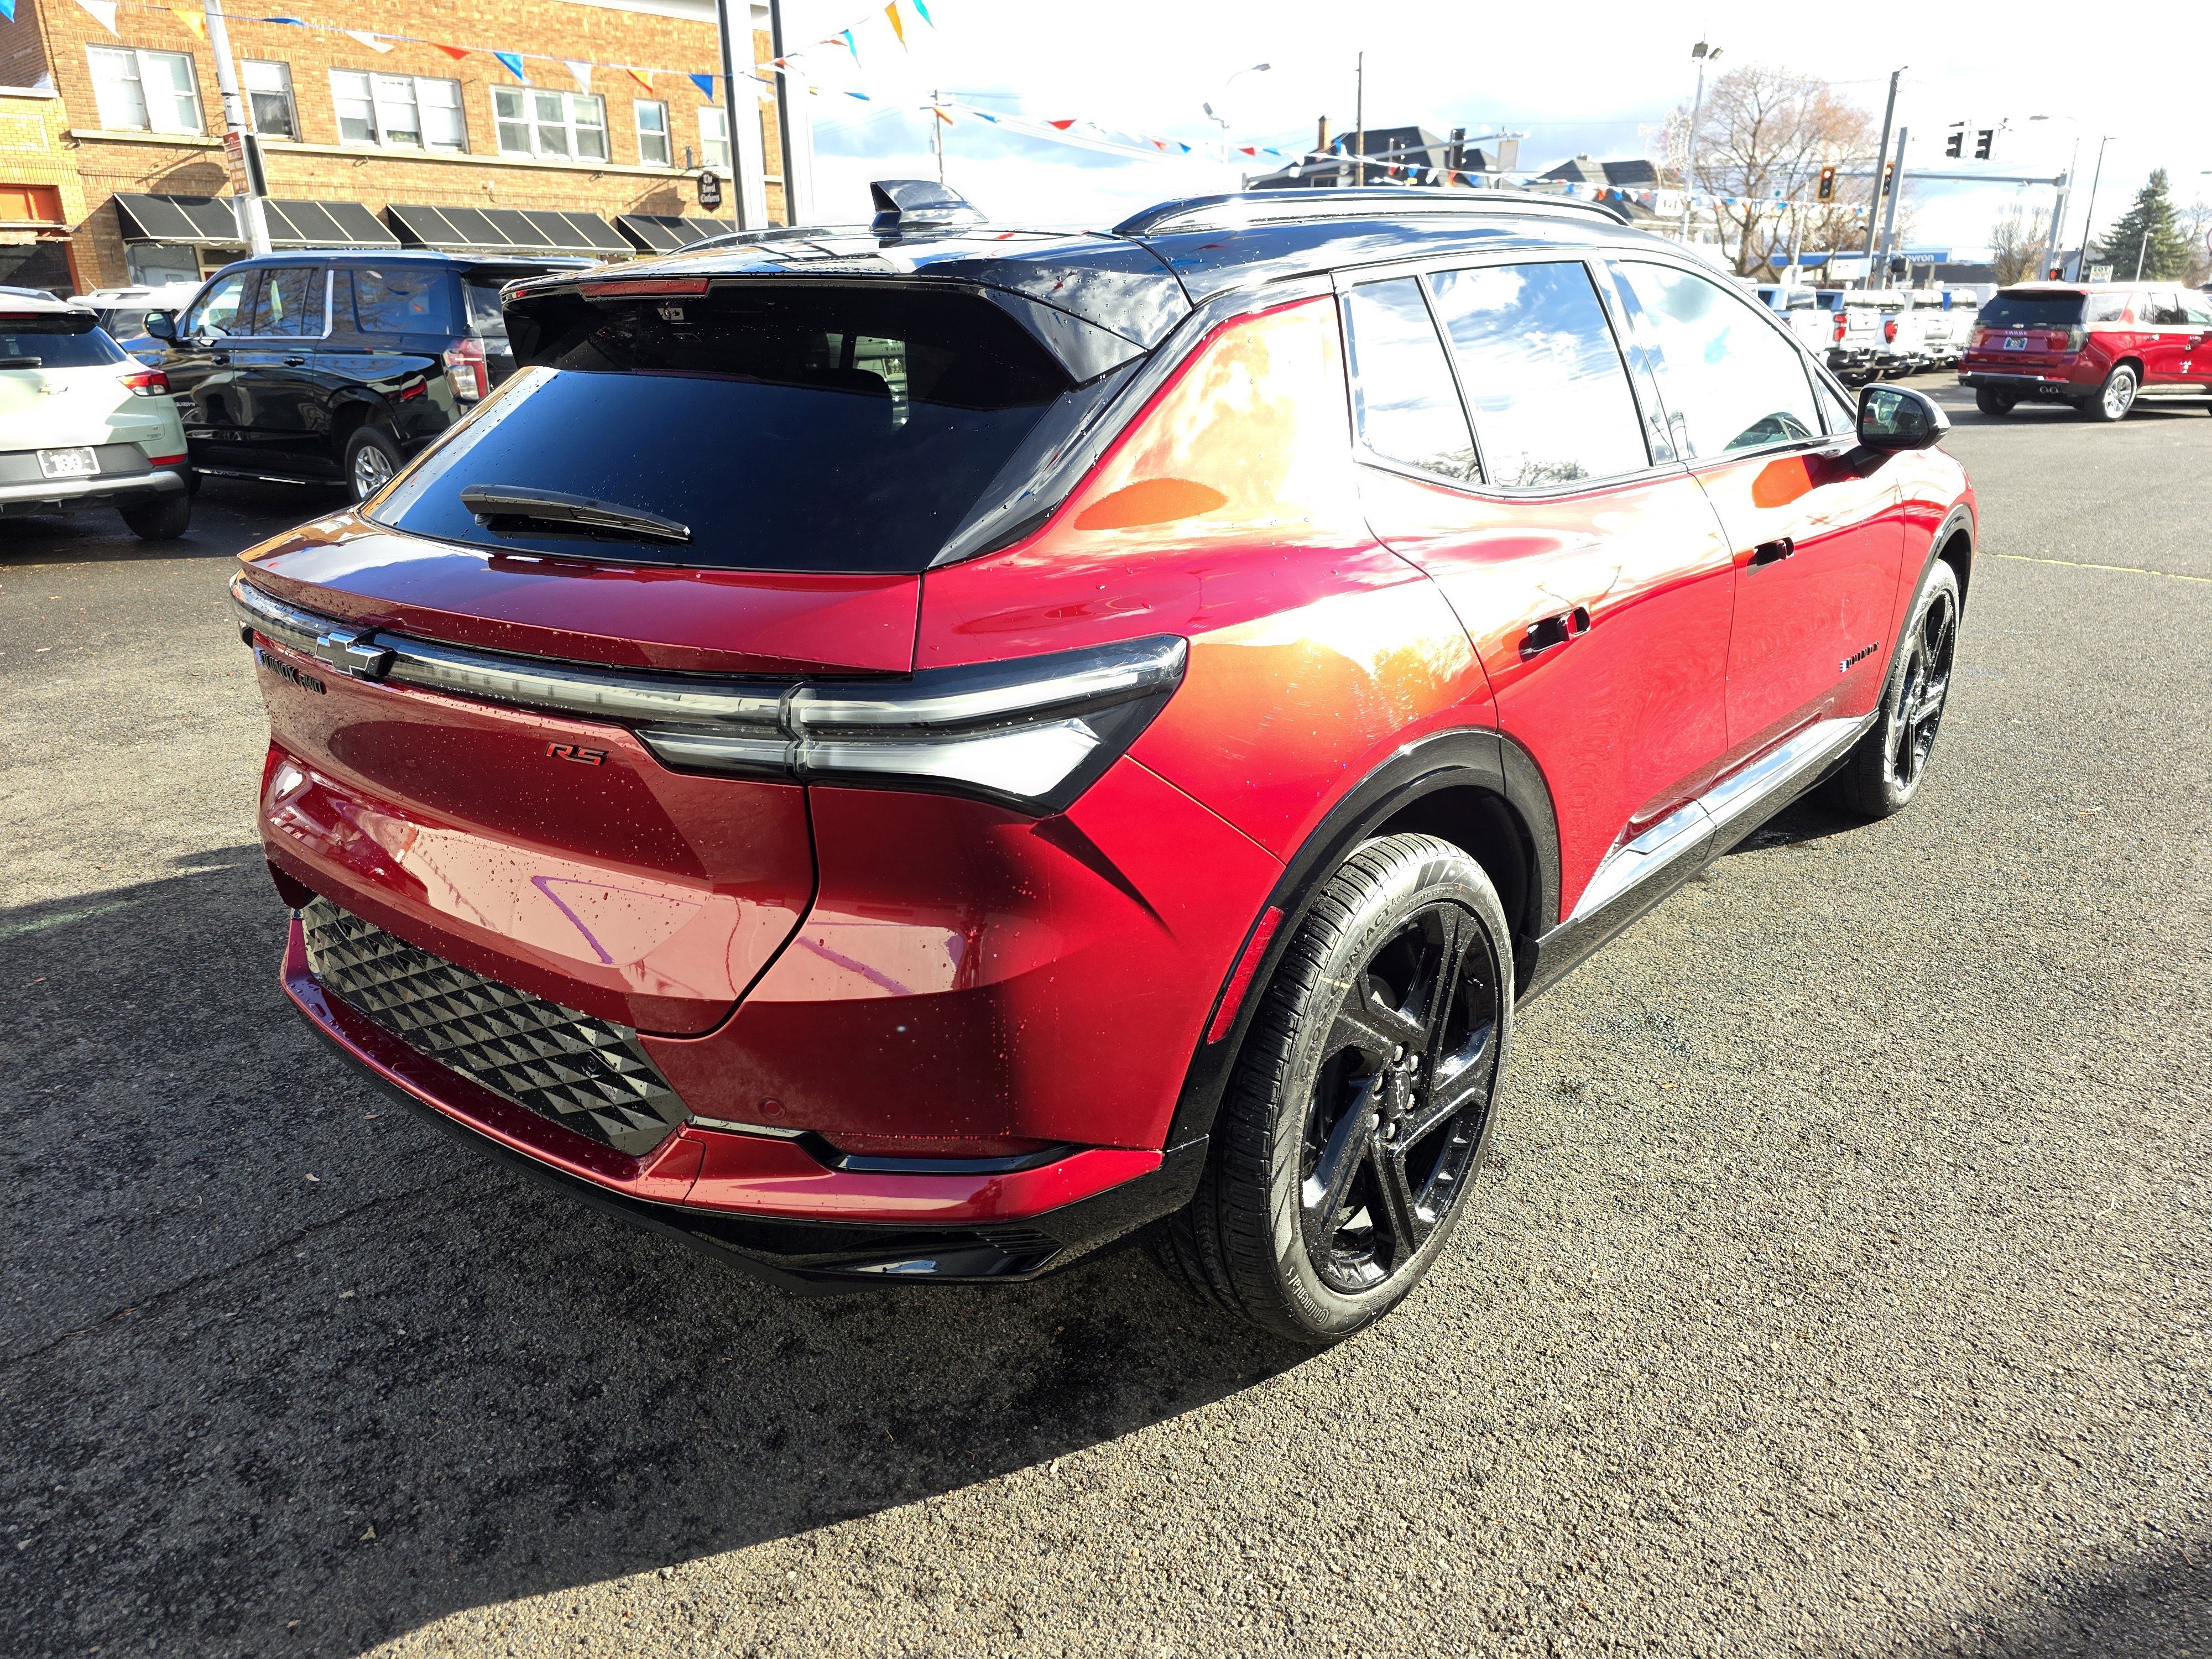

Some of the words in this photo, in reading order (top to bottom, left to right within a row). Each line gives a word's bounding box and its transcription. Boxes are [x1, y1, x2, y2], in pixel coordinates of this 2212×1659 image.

[254, 647, 301, 687] EQUINOX
[544, 742, 609, 766] RS
[1292, 1276, 1330, 1326] Continental
